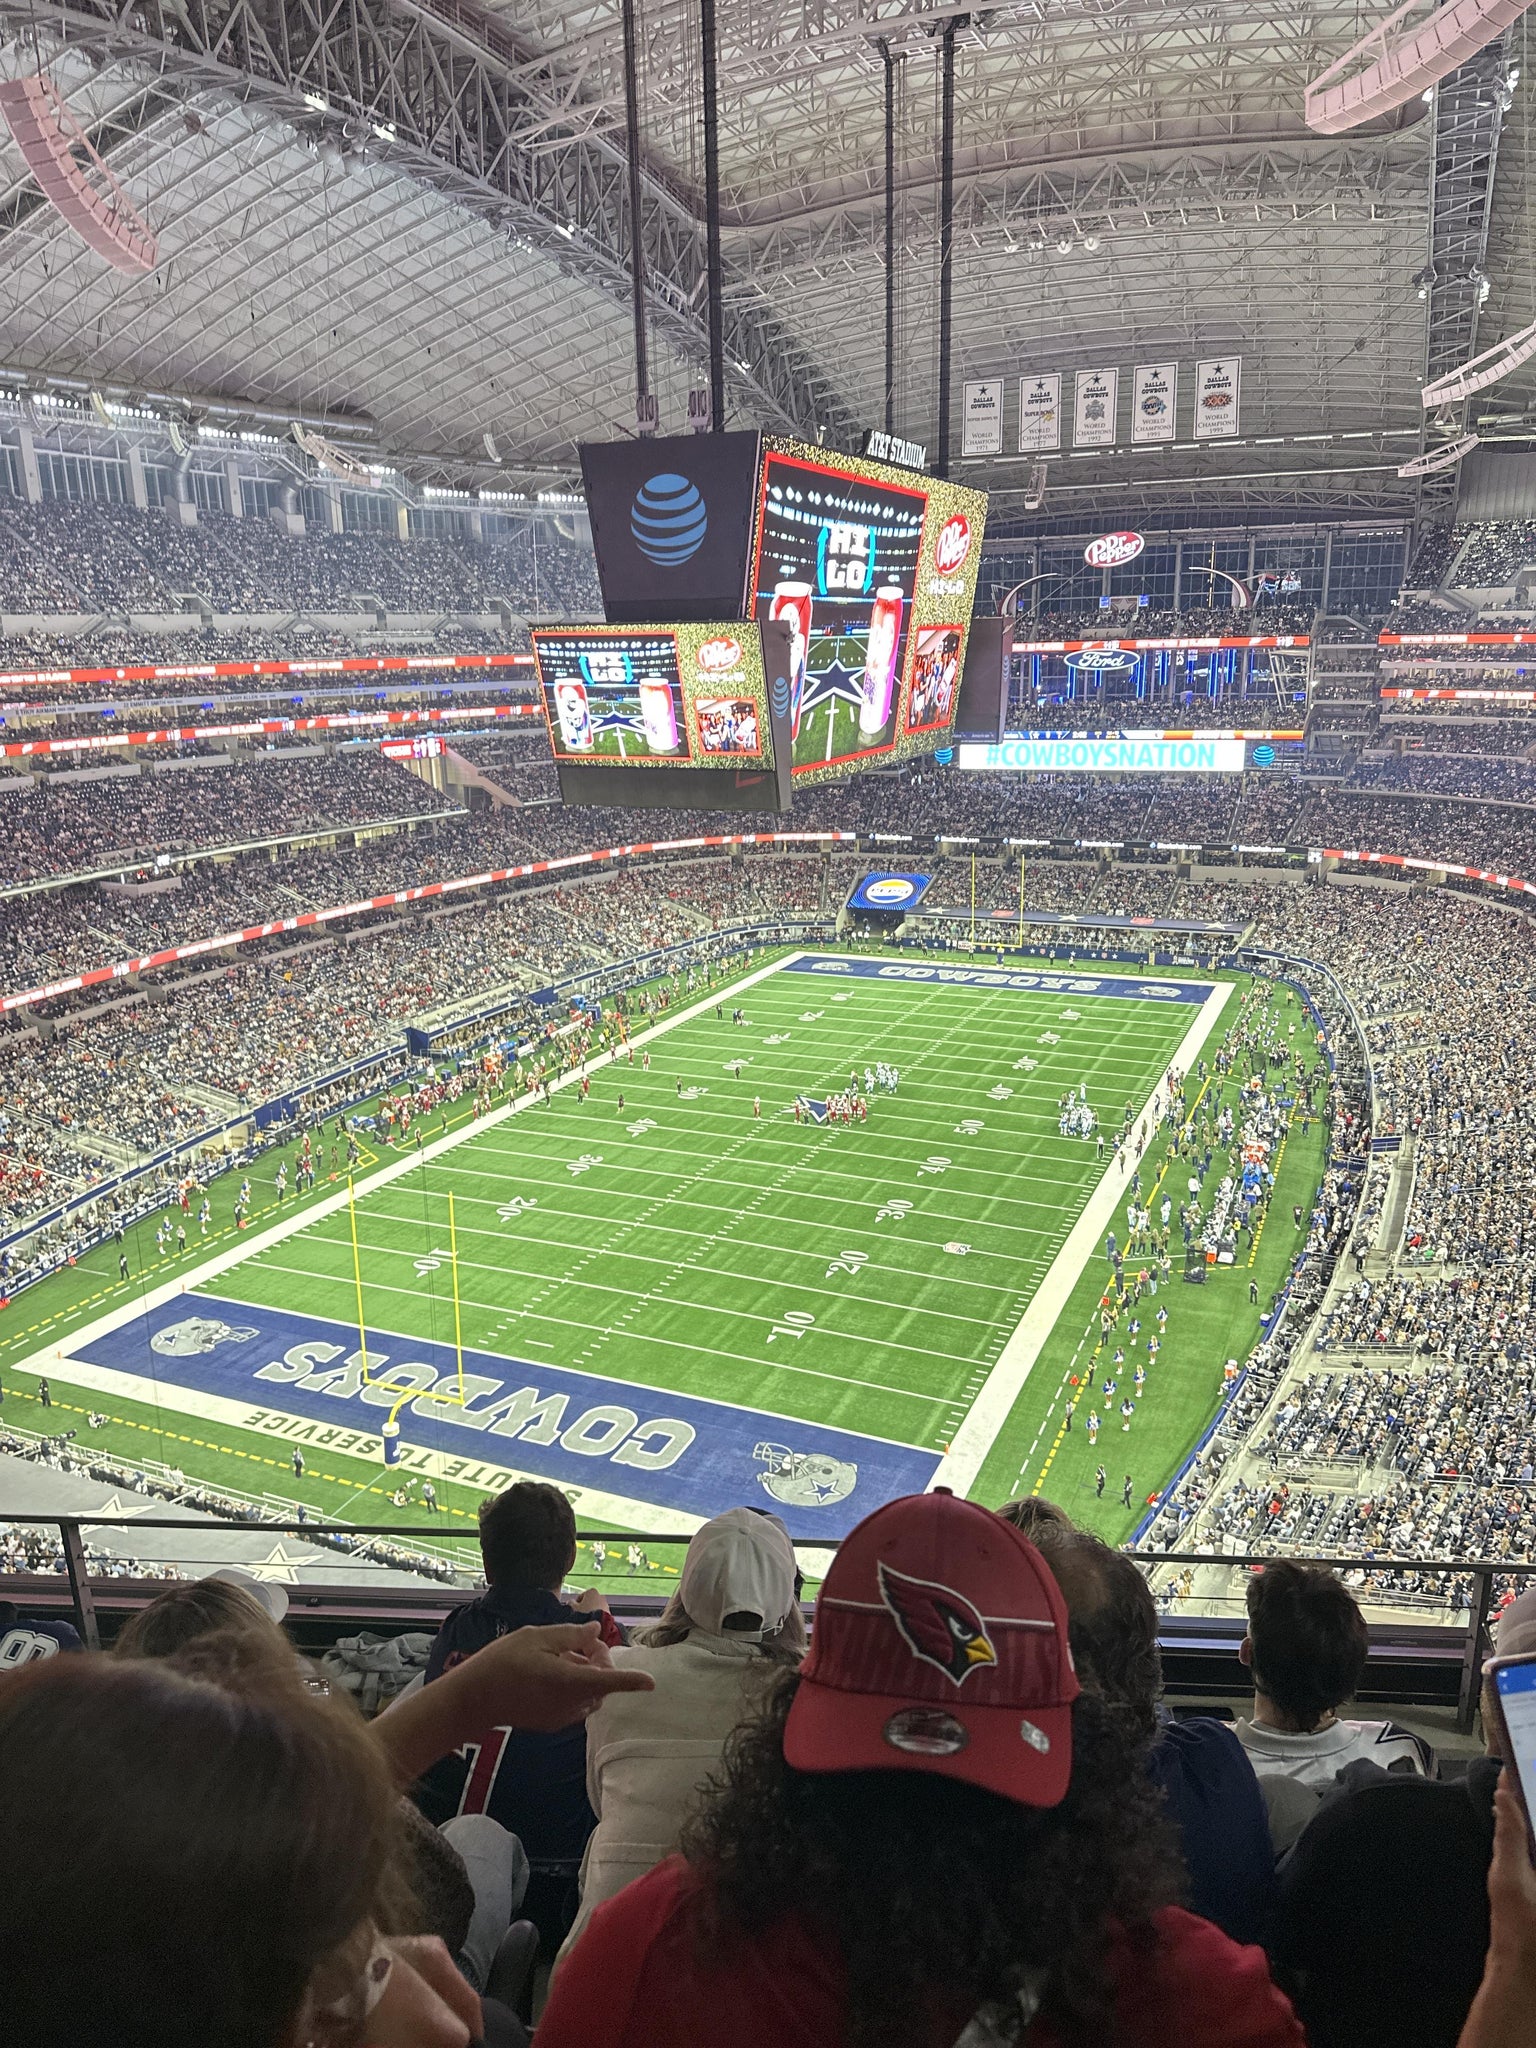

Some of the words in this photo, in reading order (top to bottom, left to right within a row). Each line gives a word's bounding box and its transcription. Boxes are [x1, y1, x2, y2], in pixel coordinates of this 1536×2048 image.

[1204, 382, 1232, 390] COWBOYS
[1198, 420, 1235, 429] CHAMPIONS
[867, 430, 891, 460] AT&T
[890, 437, 926, 470] STADIUM
[1092, 539, 1139, 564] Pepper
[1105, 535, 1127, 550] Dr
[1079, 651, 1126, 667] Ford
[987, 742, 1215, 767] #COWBOYSNATION
[878, 966, 1102, 991] COWBOYS
[626, 1118, 658, 1133] 40
[954, 1119, 985, 1135] 50
[566, 1154, 604, 1172] 30
[920, 1156, 952, 1174] 40
[496, 1195, 538, 1216] 20
[877, 1199, 914, 1220] 30
[413, 1248, 459, 1270] 10
[828, 1250, 869, 1275] 20
[772, 1311, 816, 1339] 10
[253, 1341, 697, 1470] COWBOYS
[242, 1411, 382, 1454] SERVICE
